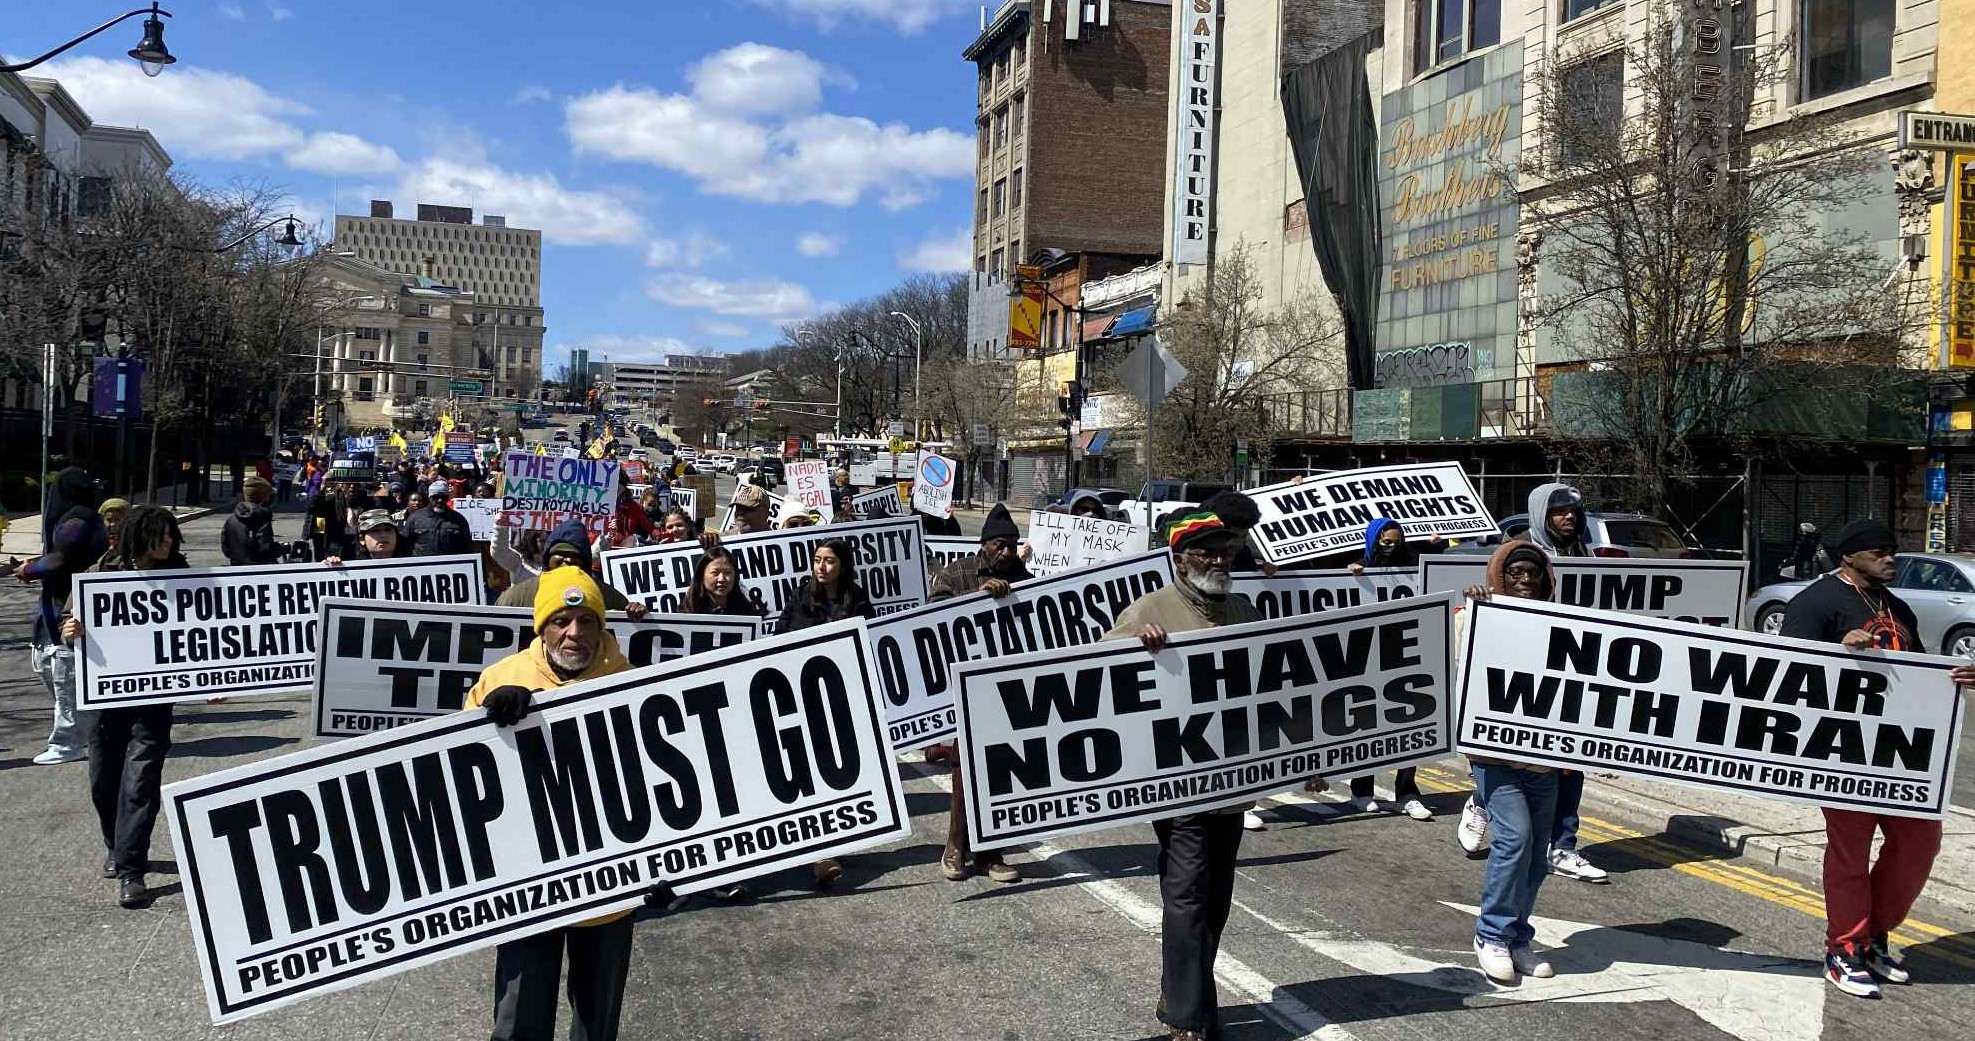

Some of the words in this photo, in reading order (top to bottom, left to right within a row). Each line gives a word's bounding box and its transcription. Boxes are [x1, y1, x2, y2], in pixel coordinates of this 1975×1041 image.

[1186, 42, 1210, 240] FURNITURE
[1451, 230, 1468, 247] OF
[1472, 222, 1499, 242] FINE
[1391, 249, 1498, 291] FURNITURE
[508, 455, 554, 480] THE
[559, 458, 617, 488] ONLY
[788, 463, 825, 476] NADIE
[798, 477, 815, 490] ES
[502, 496, 589, 513] DESTROYING
[504, 478, 608, 503] MINORITY
[670, 491, 691, 506] OW
[800, 490, 831, 507] EGAL
[1271, 488, 1327, 515] WE
[1326, 474, 1443, 503] DEMAND
[1072, 518, 1100, 533] TAKE
[1106, 524, 1138, 537] OFF
[1260, 504, 1374, 542] HUMAN
[1375, 495, 1477, 520] RIGHTS
[1274, 538, 1329, 557] PEOPLE'S
[1414, 524, 1433, 535] FOR
[1434, 519, 1488, 533] PROGRESS
[1033, 552, 1071, 567] WHEN
[1050, 532, 1071, 547] MY
[1082, 535, 1125, 552] MASK
[620, 559, 667, 595] WE
[671, 544, 785, 588] DAND
[93, 589, 169, 628] PASS
[177, 583, 271, 622] POLICE
[273, 577, 378, 616] REVIEW
[385, 572, 469, 604] BOARD
[1560, 573, 1683, 610] UMP
[154, 619, 317, 665] LEGISLATIO
[98, 674, 190, 696] PEOPLE'S
[195, 664, 315, 688] ORGANIZATI
[878, 635, 909, 706] O
[997, 660, 1162, 731] WE
[1187, 619, 1422, 704] HAVE
[1546, 626, 1662, 683] NO
[1687, 646, 1888, 717] WAR
[889, 712, 943, 742] OPLE'S
[984, 728, 1123, 797] NO
[1152, 673, 1436, 770] KINGS
[1486, 667, 1679, 739] WITH
[1696, 702, 1936, 772] IRAN
[991, 794, 1102, 830] PEOPLE'S
[1107, 763, 1275, 809] ORGANIZATION
[1281, 753, 1322, 776] FOR
[1326, 729, 1438, 769] PROGRESS
[1472, 723, 1575, 754] PEOPLE'S
[1581, 738, 1755, 782] ORGANIZATION
[1759, 766, 1806, 789] FOR
[1810, 772, 1929, 804] PROGRESS
[207, 742, 504, 946] TRUMP
[515, 686, 738, 862] MUST
[747, 655, 861, 805] GO
[238, 930, 395, 994] PEOPLE'S
[402, 858, 642, 946] ORGANIZATION
[647, 842, 708, 880] FOR
[715, 800, 879, 863] PROGRESS
